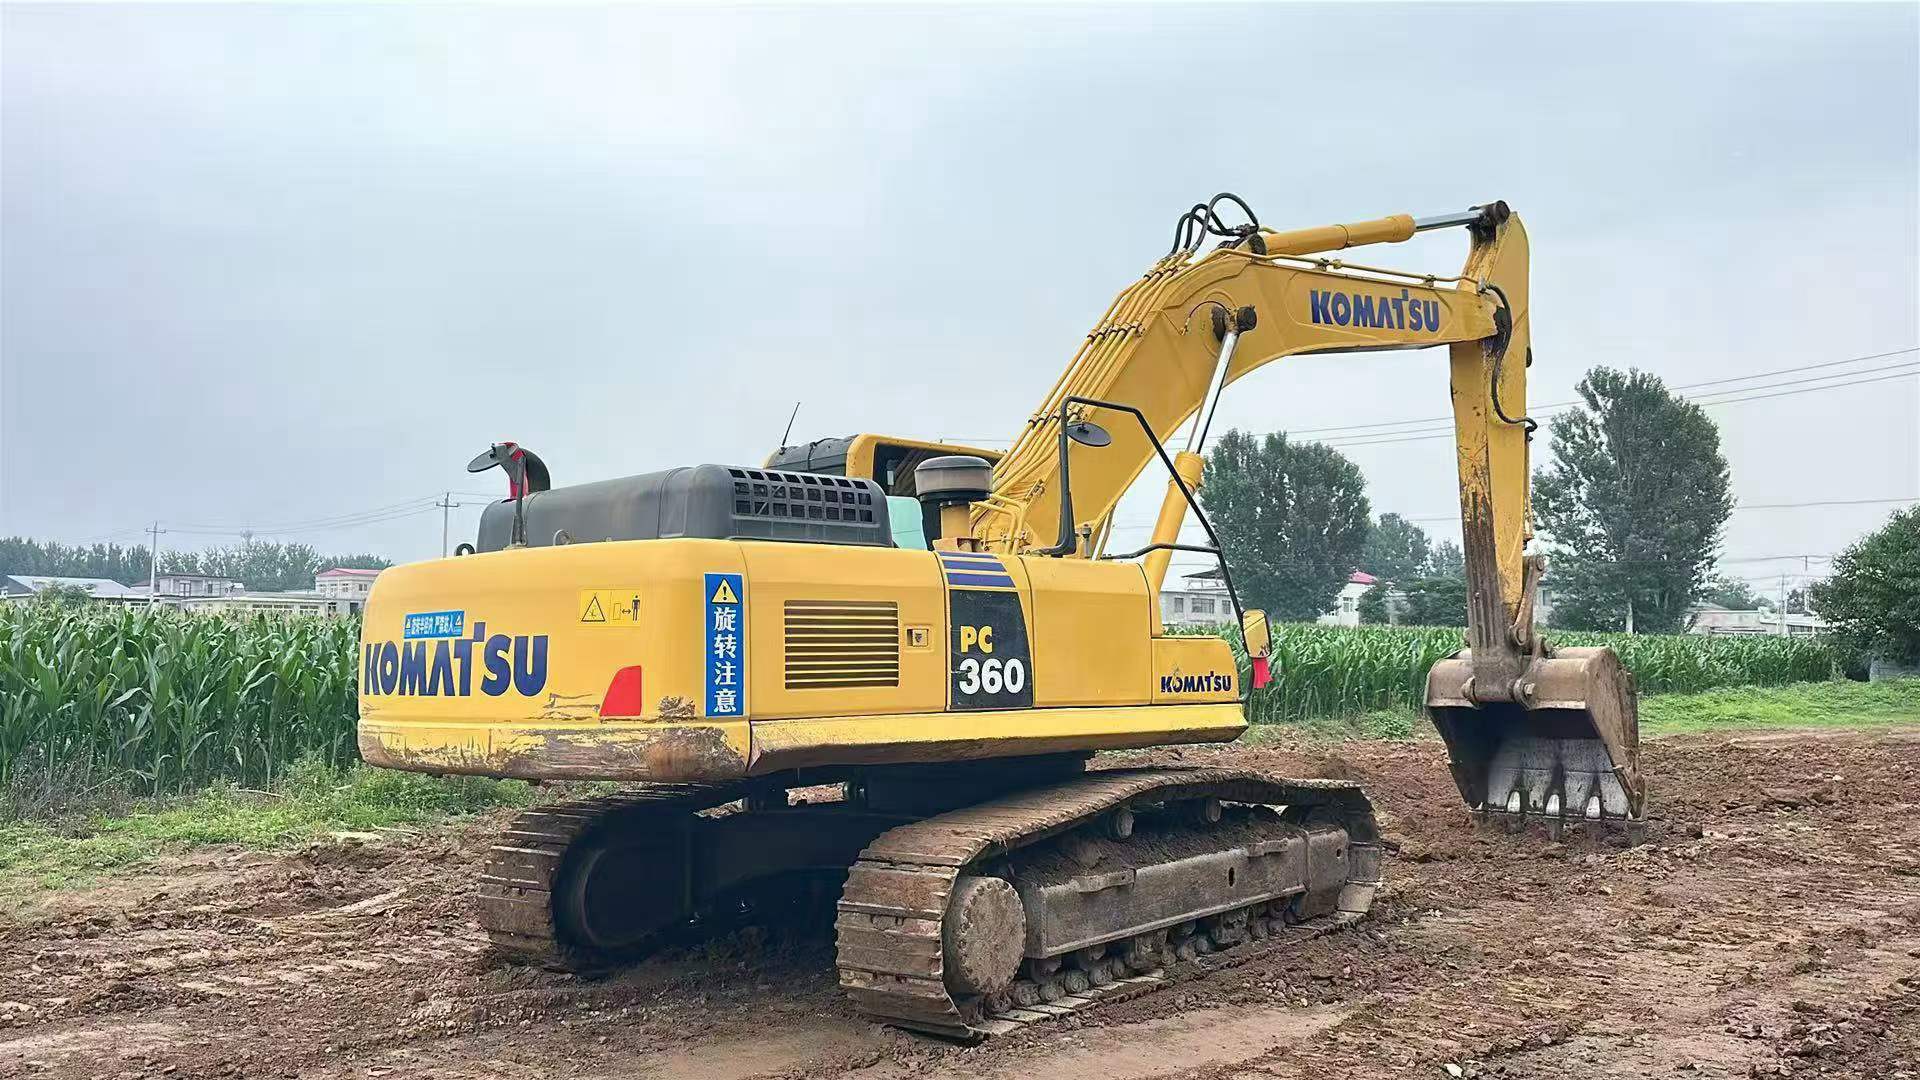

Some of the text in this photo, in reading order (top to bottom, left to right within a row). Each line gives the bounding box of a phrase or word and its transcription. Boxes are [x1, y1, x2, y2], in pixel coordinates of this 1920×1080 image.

[1310, 288, 1440, 333] KOMATSU
[364, 622, 549, 697] KOMATSU
[713, 606, 737, 713] 旋转注意
[960, 625, 993, 653] PC
[958, 658, 1025, 695] 360
[1160, 671, 1232, 693] KOMATSU
